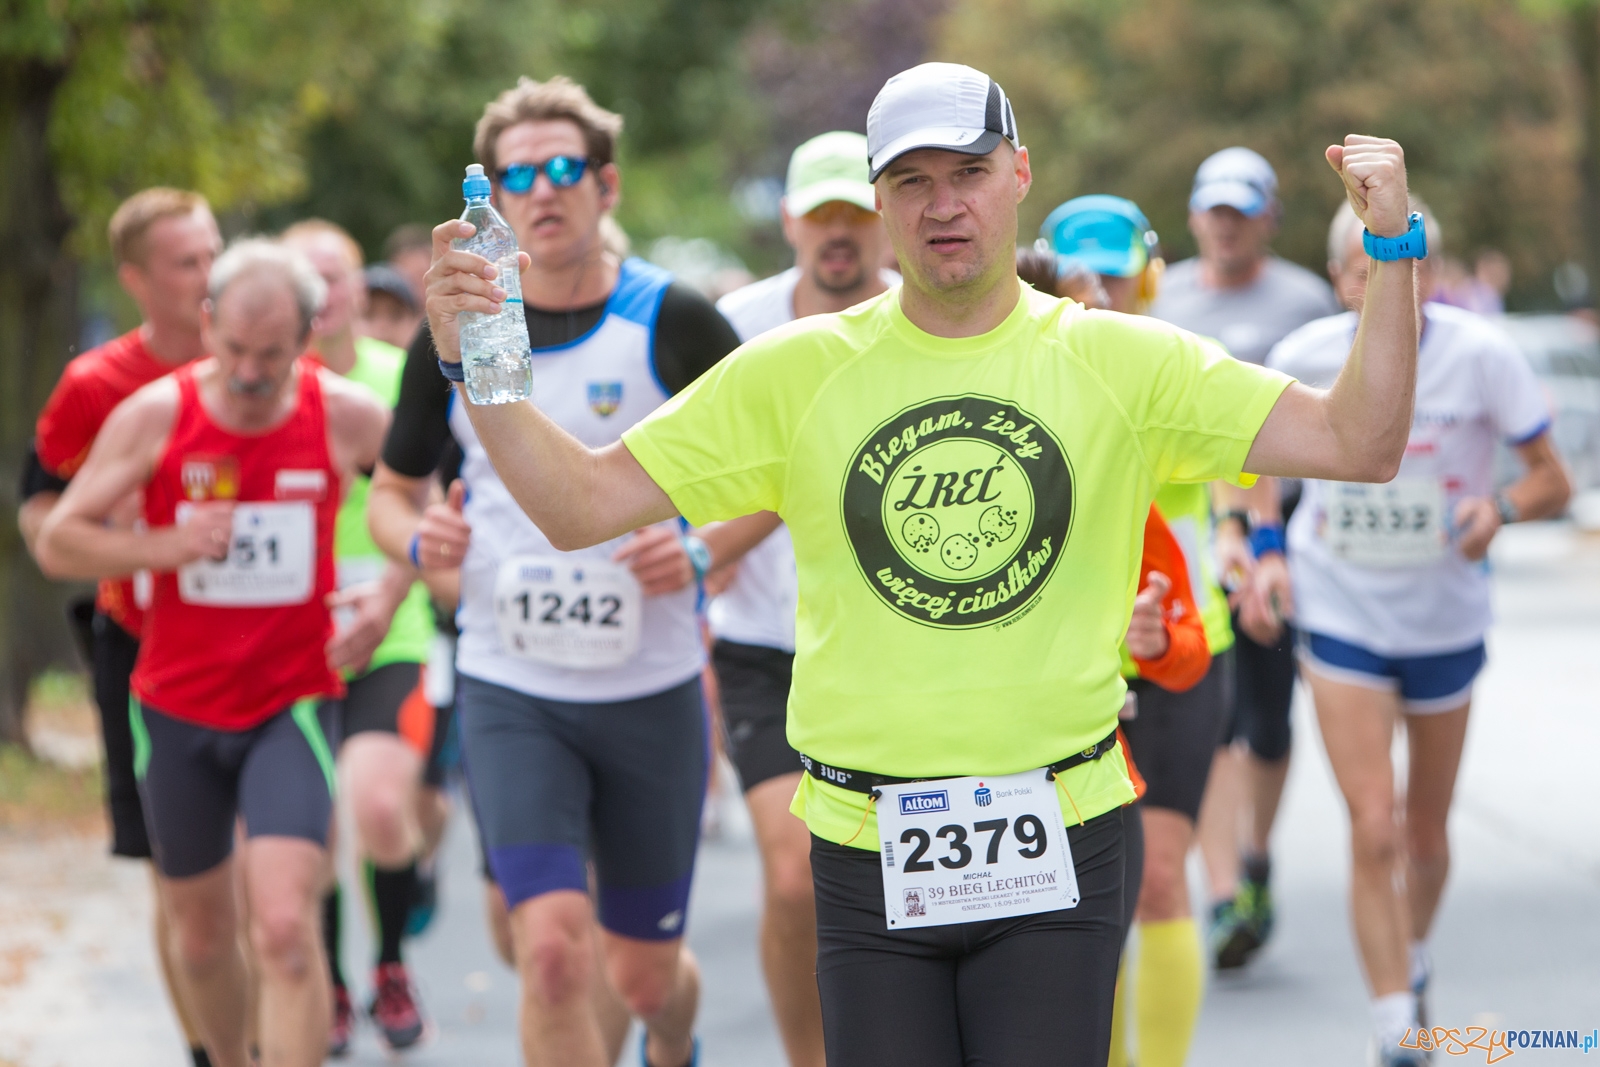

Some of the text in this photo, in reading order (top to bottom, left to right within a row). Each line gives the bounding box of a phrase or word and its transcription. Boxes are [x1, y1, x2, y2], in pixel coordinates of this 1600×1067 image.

[859, 410, 1042, 485] Biegam, żeby
[894, 454, 1007, 511] ŻREĆ
[876, 536, 1052, 619] więcej ciastków
[514, 589, 622, 627] 1242
[996, 787, 1032, 799] Bank Polski
[900, 814, 1048, 873] 2379
[928, 870, 1057, 900] 39 BIEG LECHITÓW
[962, 871, 992, 881] MICHAŁ
[938, 898, 971, 906] MISTRZOSTWA
[990, 892, 1013, 900] LEKARZY
